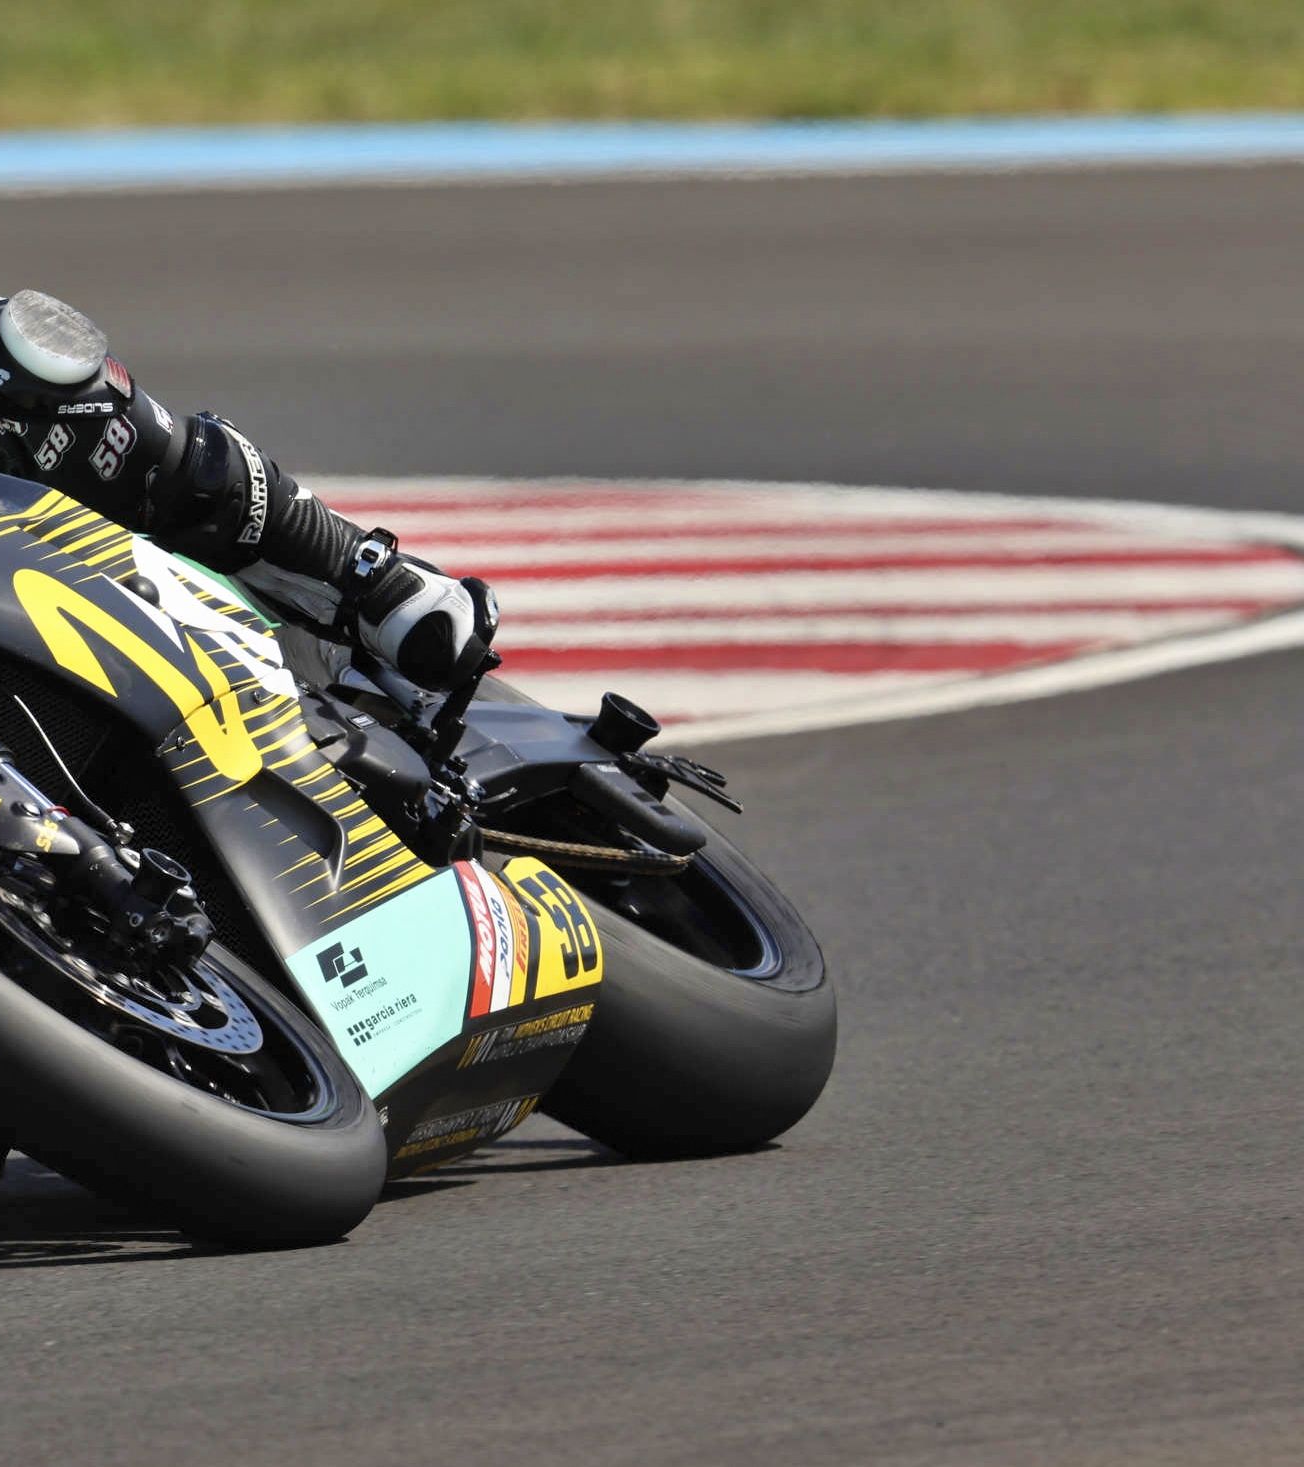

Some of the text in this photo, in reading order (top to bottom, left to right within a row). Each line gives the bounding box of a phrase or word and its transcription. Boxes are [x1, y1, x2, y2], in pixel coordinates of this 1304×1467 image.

[58, 402, 114, 415] SLIDERS
[35, 423, 76, 471] 58
[89, 413, 137, 481] 58
[462, 876, 494, 986] MOTUL
[516, 870, 598, 980] 58
[330, 994, 356, 1012] Vopak
[394, 993, 417, 1012] riera
